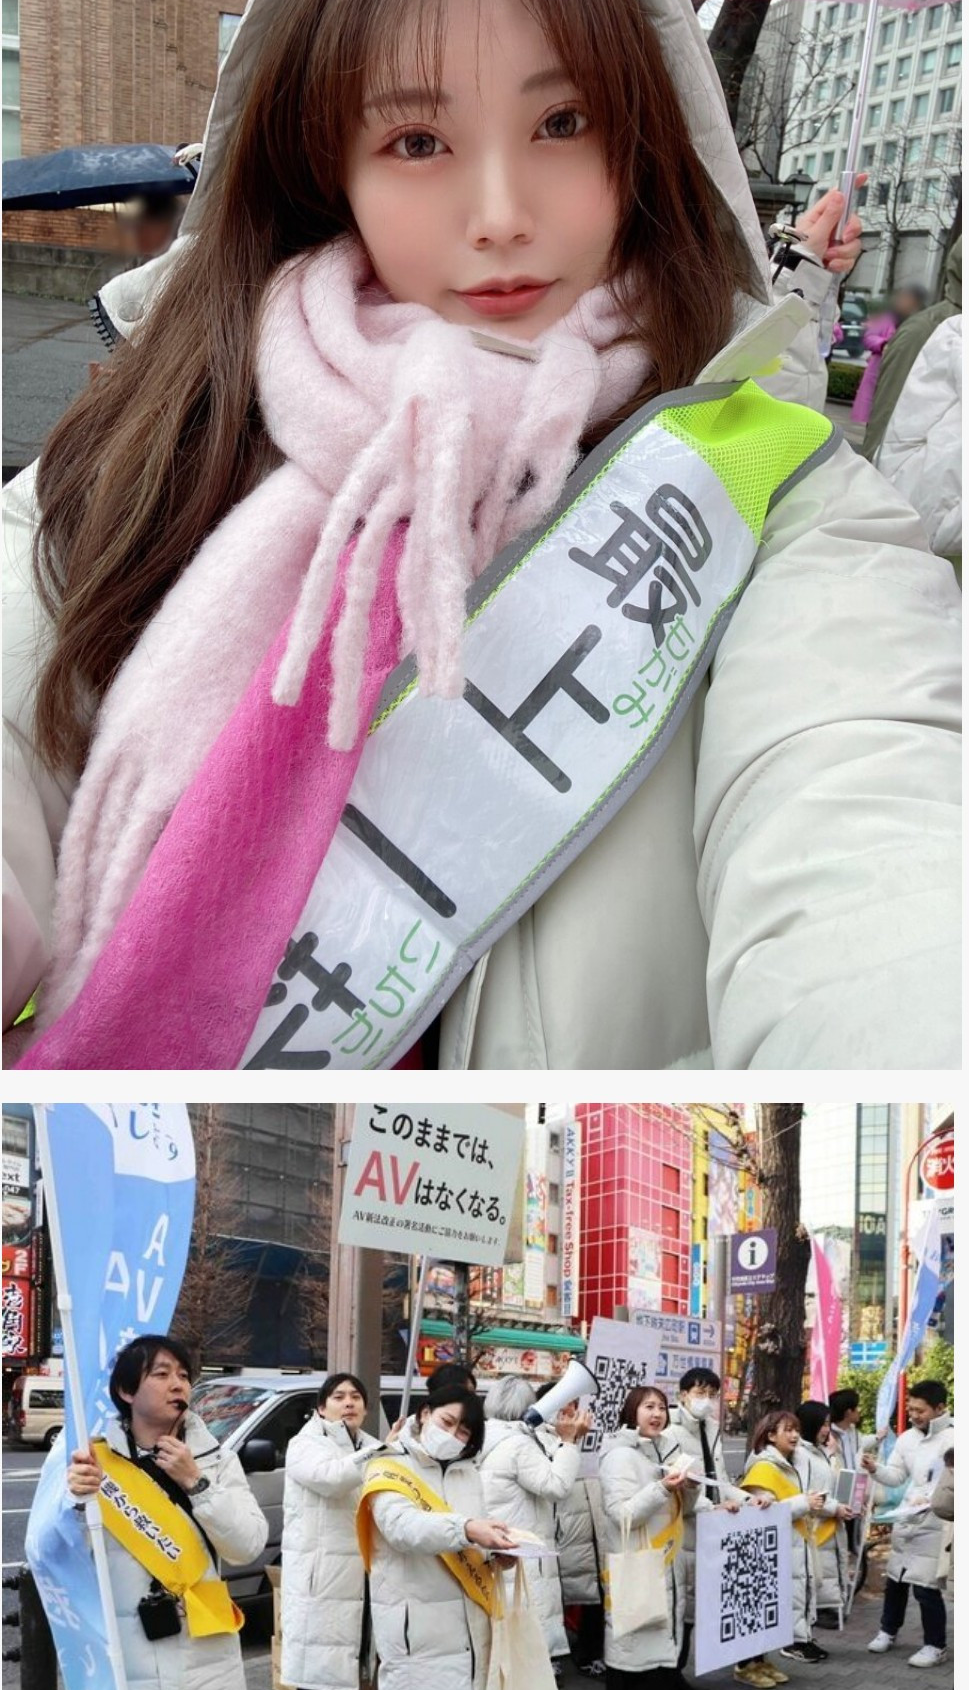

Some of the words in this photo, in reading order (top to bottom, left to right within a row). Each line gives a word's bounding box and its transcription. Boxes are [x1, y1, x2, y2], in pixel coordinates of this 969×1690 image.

[612, 615, 695, 730] もがみ
[332, 920, 441, 1056] いちか
[369, 1104, 493, 1169] このままでは、
[353, 1150, 506, 1225] AVはなくなる。
